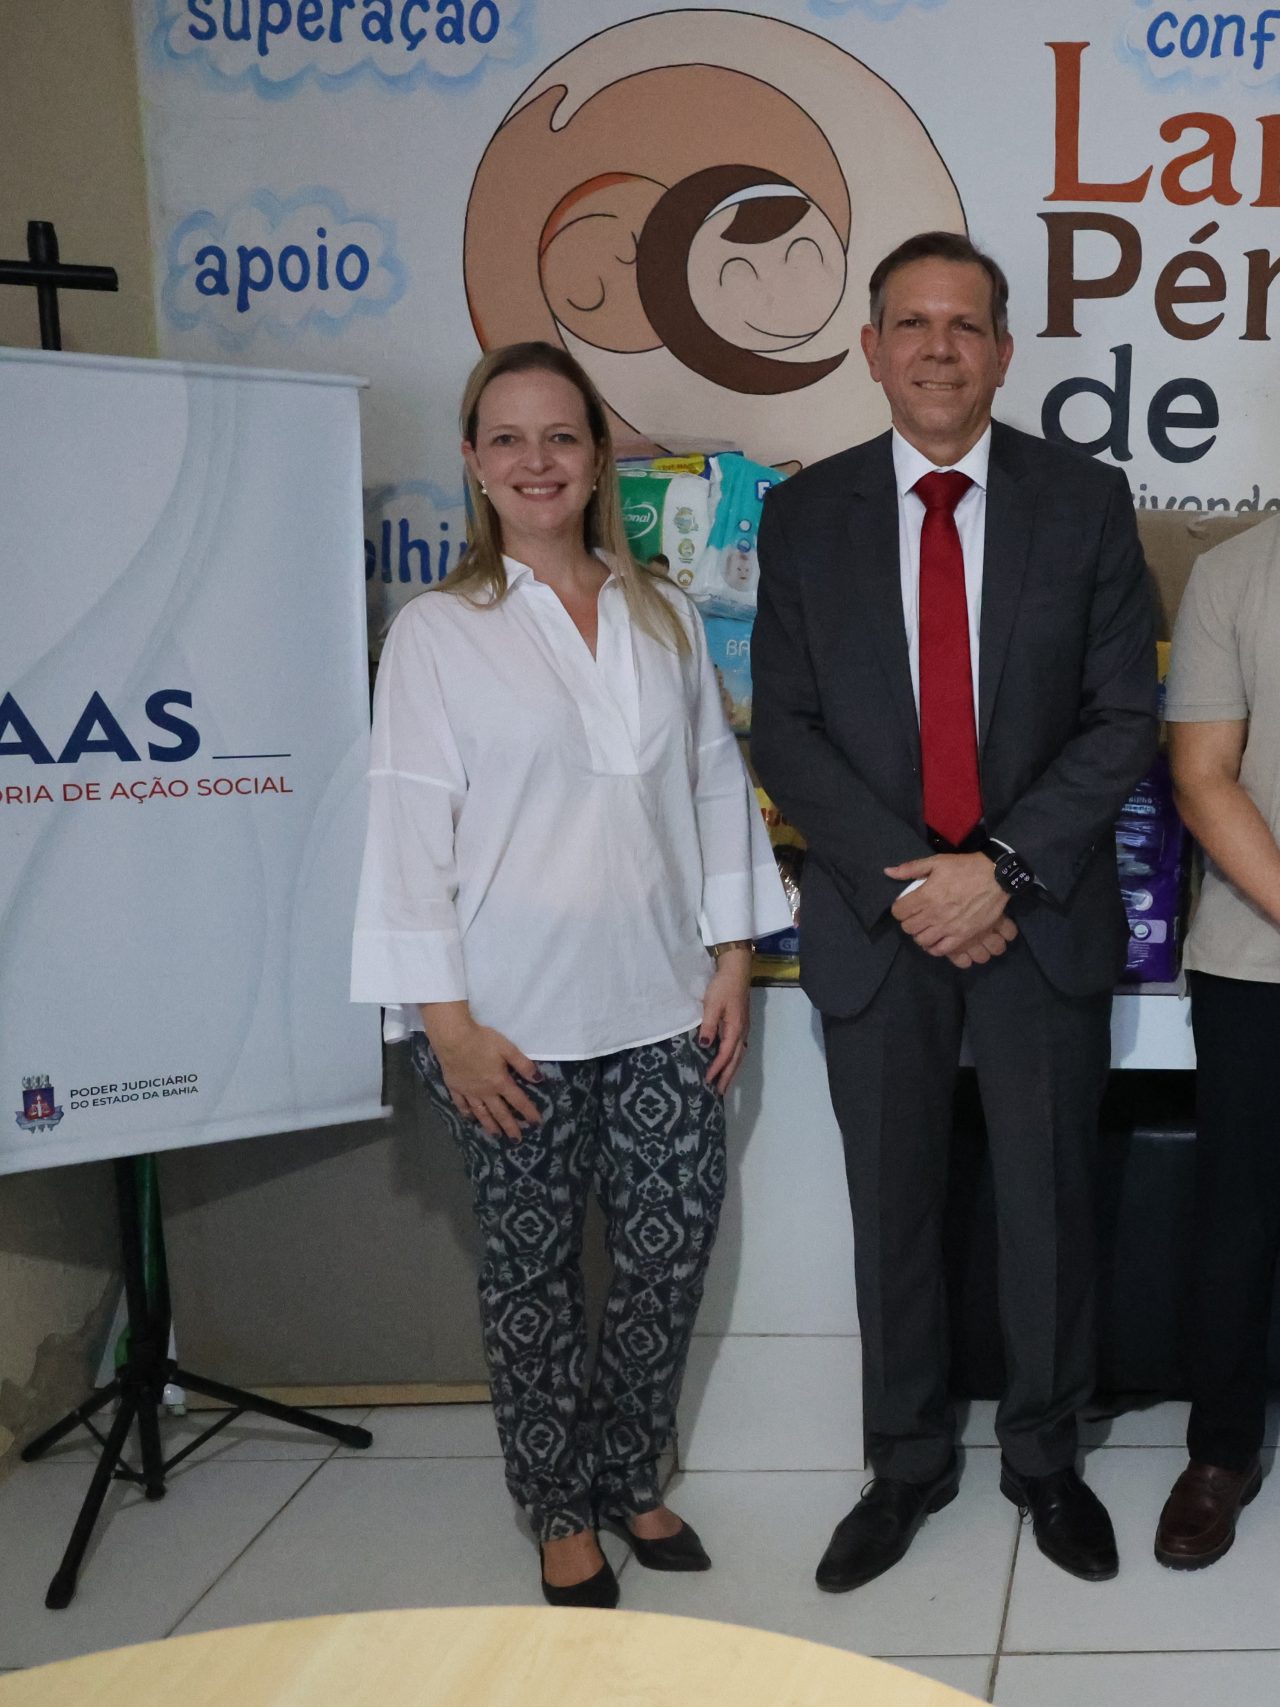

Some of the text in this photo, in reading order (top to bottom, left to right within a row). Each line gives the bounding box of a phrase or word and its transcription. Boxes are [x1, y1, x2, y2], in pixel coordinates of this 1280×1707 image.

[195, 227, 370, 313] apoio
[1041, 343, 1220, 463] de
[0, 776, 293, 804] RIA DE AÇÃO SOCIAL
[70, 1074, 198, 1099] PODER JUDICIÁRIO
[70, 1086, 199, 1110] DO ESTADO DA BAHIA
